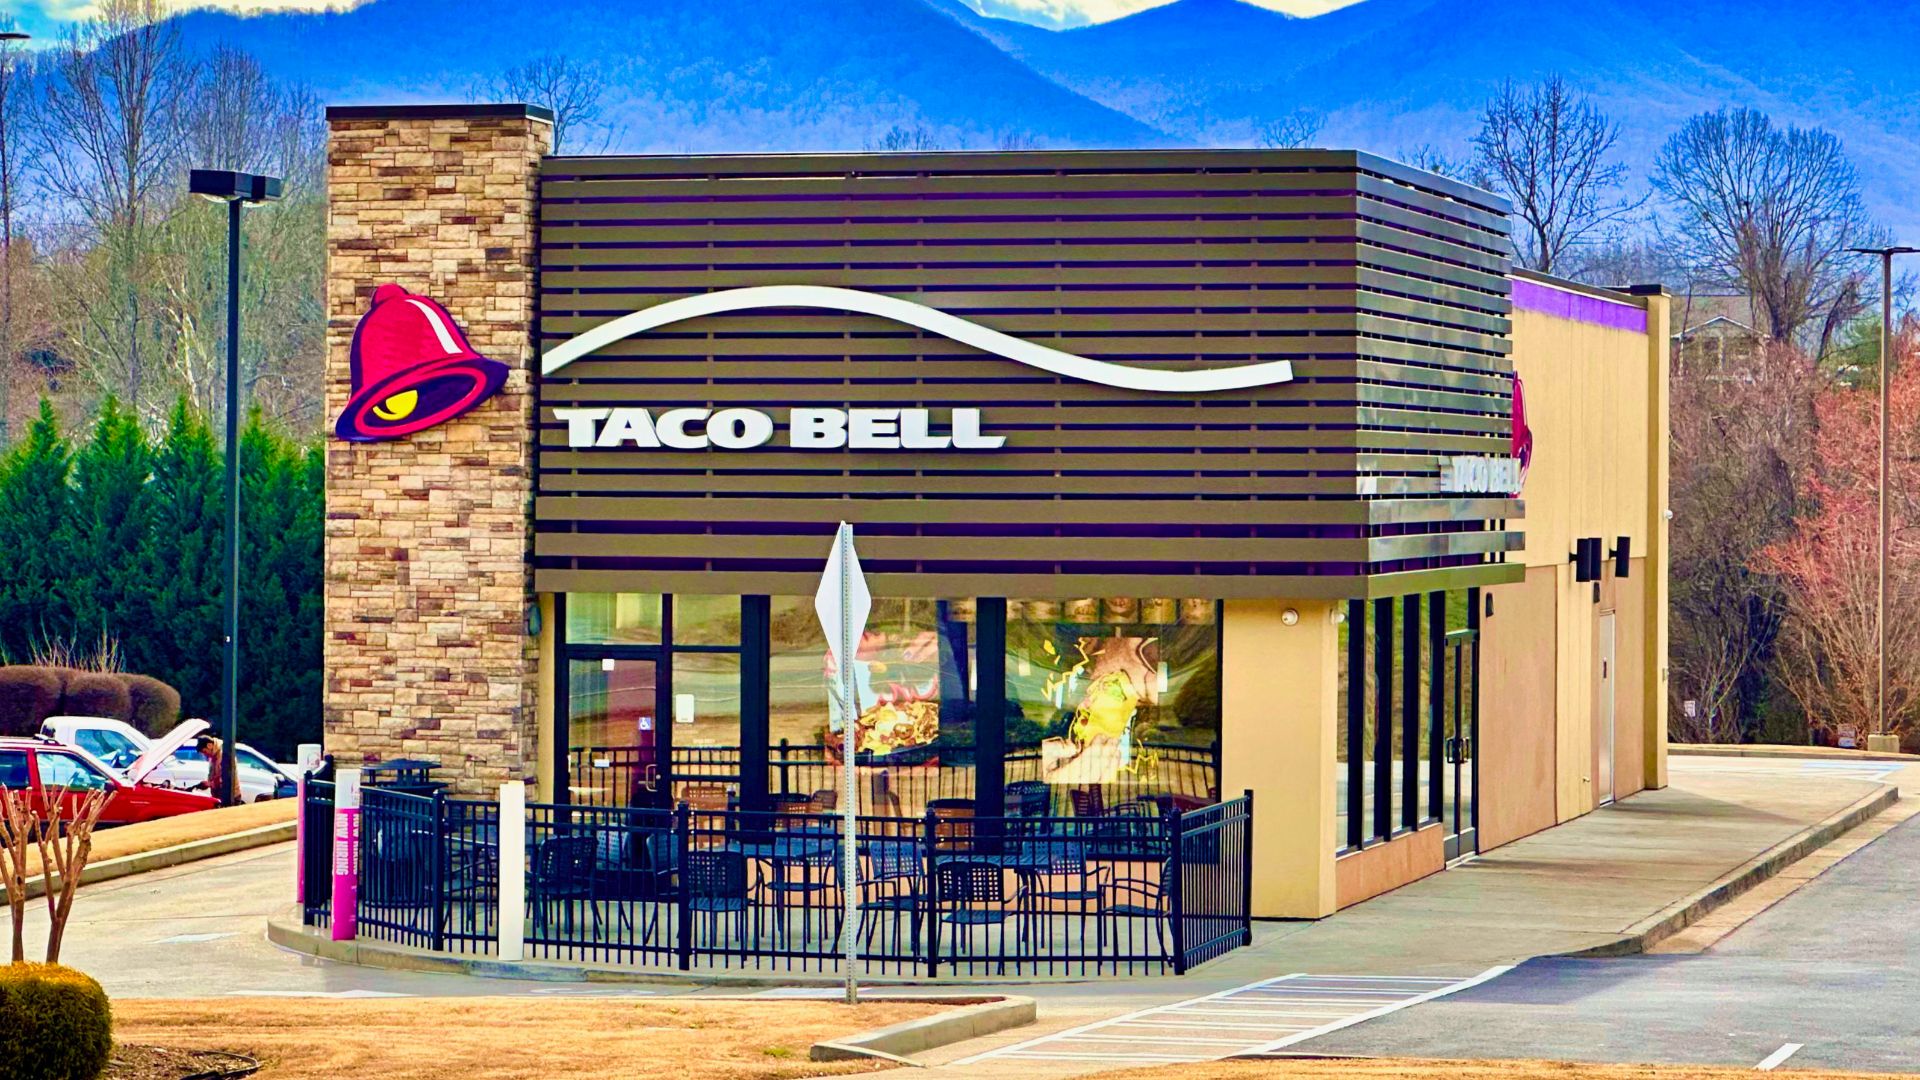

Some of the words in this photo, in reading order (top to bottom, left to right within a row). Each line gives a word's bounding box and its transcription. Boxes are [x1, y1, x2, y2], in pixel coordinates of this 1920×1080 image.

[553, 408, 773, 448] TACO
[790, 408, 1006, 448] BELL
[1450, 456, 1489, 493] TACO
[1489, 458, 1522, 493] BELL
[336, 813, 348, 838] NOW
[336, 840, 349, 875] HIRING
